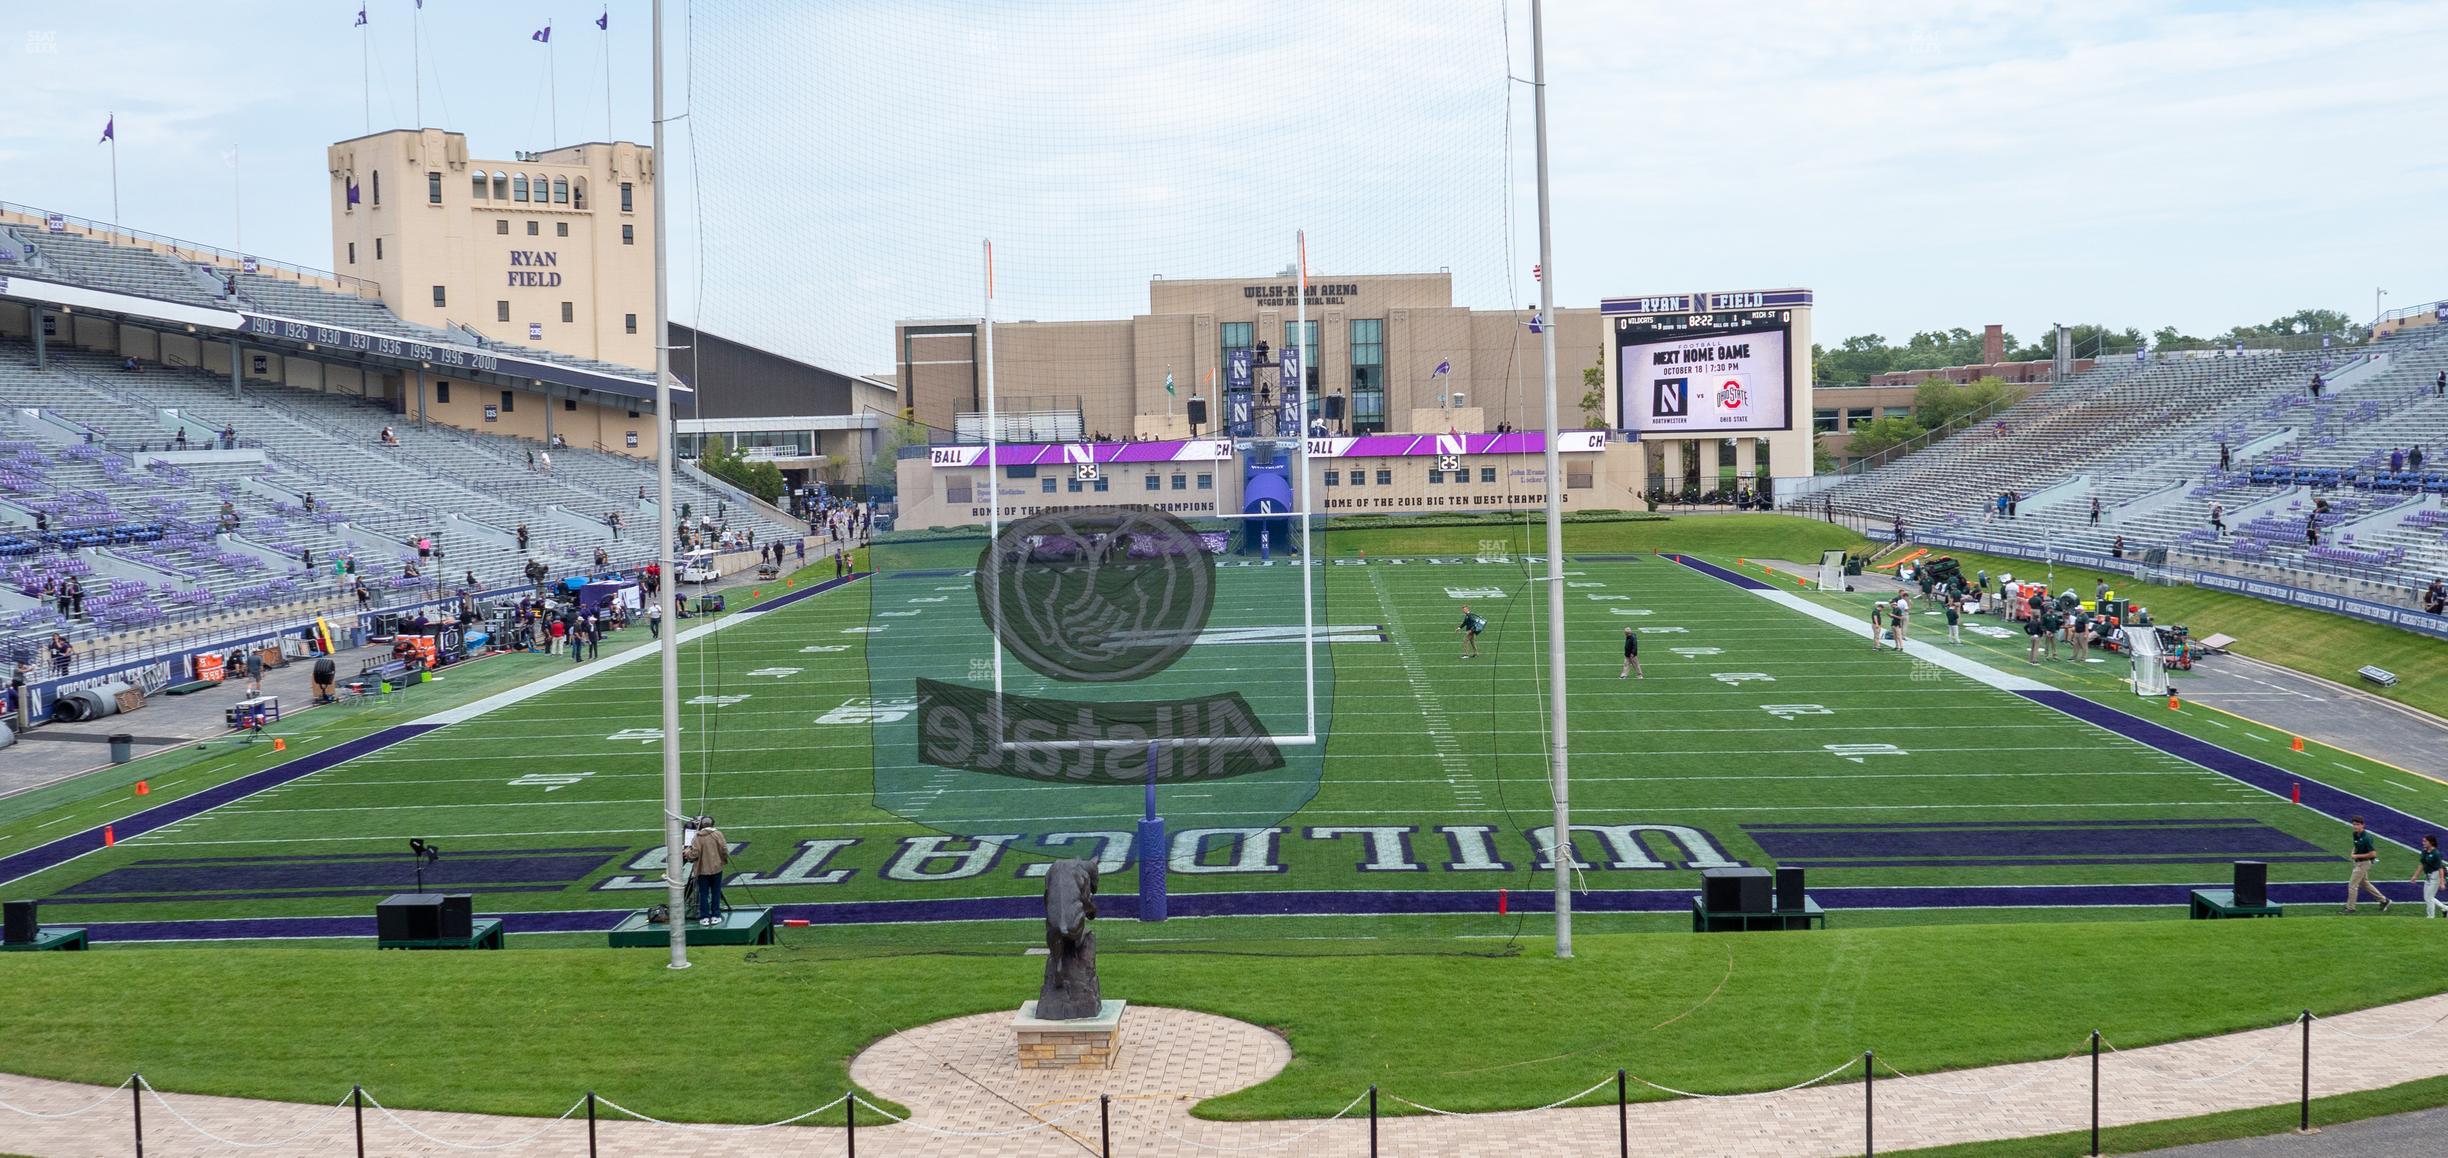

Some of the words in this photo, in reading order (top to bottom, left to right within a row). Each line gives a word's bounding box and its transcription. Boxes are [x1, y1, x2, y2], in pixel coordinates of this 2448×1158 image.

[510, 250, 557, 267] RYAN
[507, 271, 562, 287] FIELD
[1321, 284, 1358, 296] ARENA
[1326, 297, 1345, 305] HALL
[1641, 297, 1680, 313] RYAN
[1719, 293, 1763, 309] FIELD
[1628, 316, 1654, 325] WILDCATS
[1752, 311, 1766, 319] MICH
[1783, 311, 1790, 323] 0
[1620, 318, 1627, 330] 0
[252, 316, 277, 335] 1903
[285, 321, 309, 341] 1926
[317, 327, 340, 345] 1930
[349, 332, 370, 350] 1931
[378, 337, 401, 356] 1936
[410, 343, 433, 360] 1995
[441, 348, 464, 366] 1996
[472, 353, 497, 372] 2000
[1678, 341, 1721, 349] FOOTBALL
[1653, 350, 1680, 366] NEXT
[1683, 347, 1714, 363] HOME
[1717, 343, 1751, 361] GAME
[1234, 359, 1247, 379] N
[1284, 358, 1297, 378] N
[1663, 365, 1692, 376] OCTOBER
[1695, 365, 1703, 373] 18
[1710, 363, 1726, 373] 7:30
[1728, 362, 1739, 371] PM
[1660, 383, 1680, 413] N
[485, 409, 497, 418] 135
[1234, 402, 1248, 422] N
[1285, 402, 1298, 422] N
[627, 435, 638, 444] 136
[1437, 435, 1467, 454] N
[1589, 435, 1605, 448] CH
[931, 449, 962, 464] BALL
[1064, 444, 1093, 463] N
[1216, 444, 1231, 457] CH
[1441, 456, 1457, 469] 25
[1080, 465, 1096, 478] 25
[1261, 500, 1271, 514] N
[1324, 497, 1345, 508] HOME
[1356, 497, 1369, 508] OF
[1374, 497, 1394, 507] THE
[1398, 496, 1422, 506] 2018
[1427, 496, 1444, 506] BIG
[1449, 495, 1469, 506] TEN
[1474, 494, 1504, 505] WEST
[1507, 493, 1568, 504] CHAMPIS
[1004, 506, 1017, 516] OF
[1021, 505, 1041, 516] THE
[1154, 502, 1214, 513] CHAMPIONS
[183, 653, 193, 679] N
[31, 688, 43, 718] N
[1823, 743, 1910, 757] 10
[507, 771, 597, 786] 10
[598, 824, 1742, 892] WILDCATS
